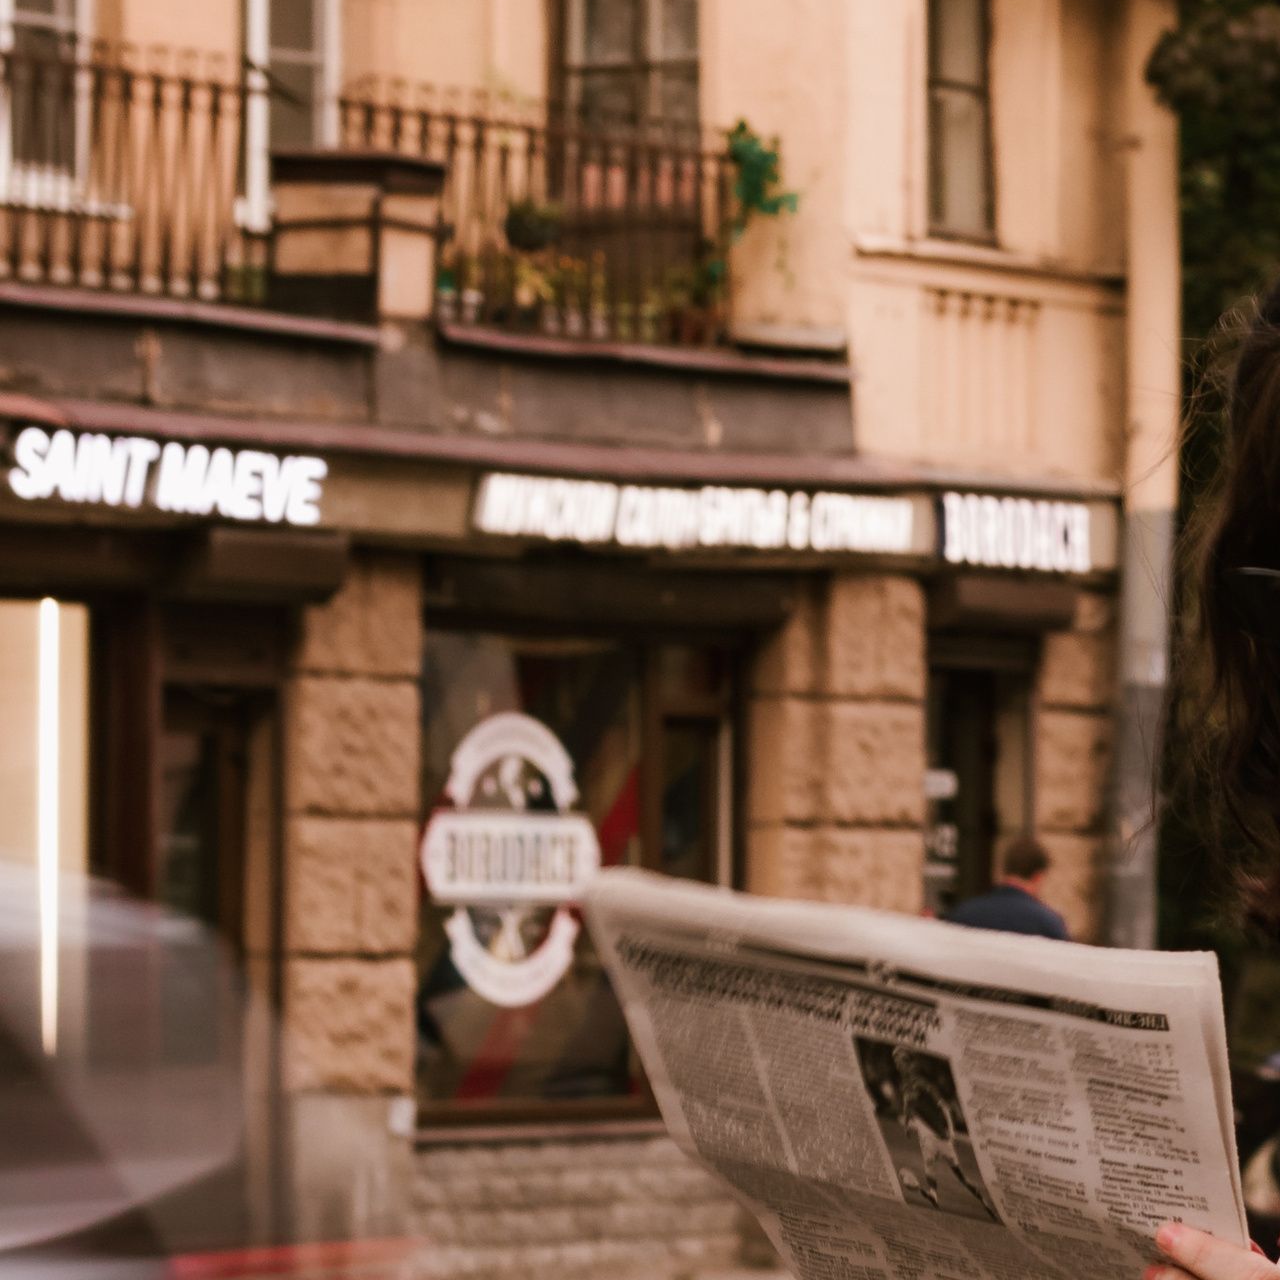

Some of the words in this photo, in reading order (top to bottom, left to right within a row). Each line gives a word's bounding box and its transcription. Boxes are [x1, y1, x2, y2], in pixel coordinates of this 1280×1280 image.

[9, 428, 158, 506] SAINT
[156, 443, 327, 525] MAEVE
[1105, 1011, 1167, 1031] УИК-ЭНД
